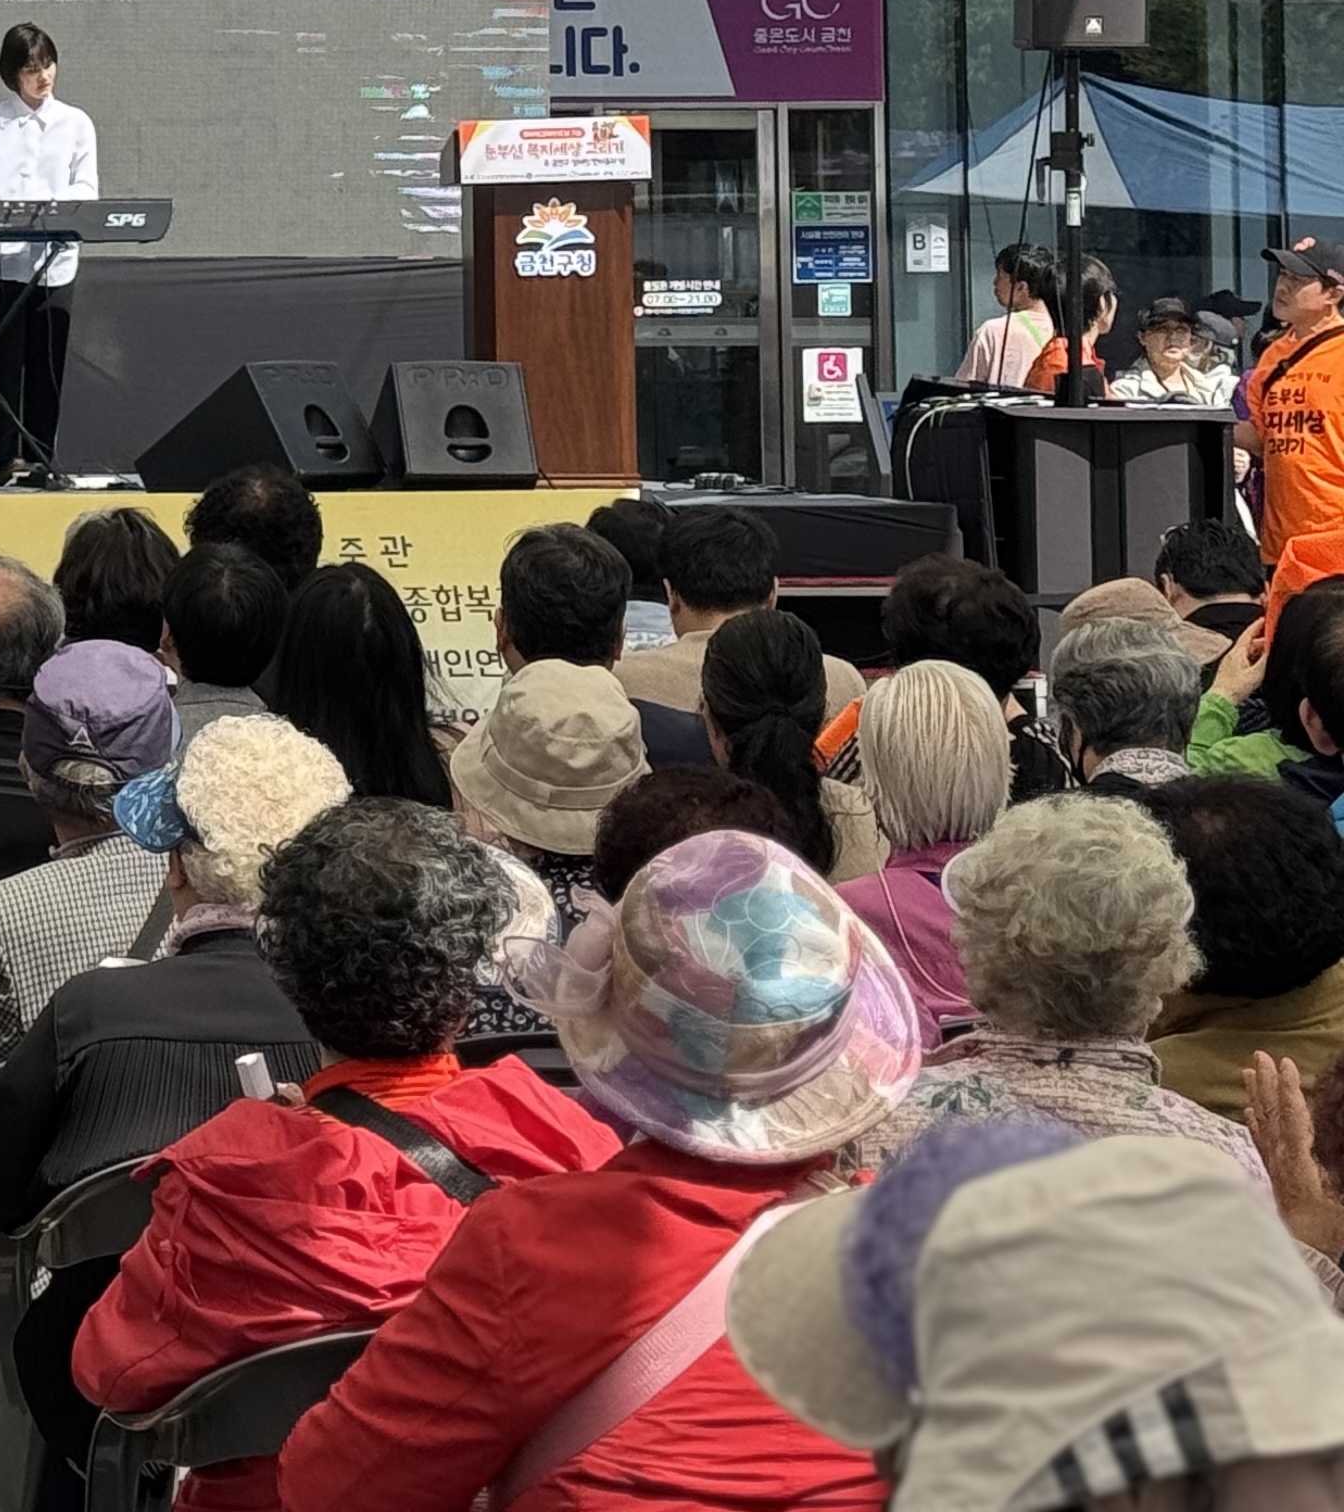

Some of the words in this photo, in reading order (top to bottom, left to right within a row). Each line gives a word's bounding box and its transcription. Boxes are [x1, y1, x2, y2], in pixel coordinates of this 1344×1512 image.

[753, 26, 816, 44] 좋은도시
[820, 26, 852, 43] 금천
[912, 233, 926, 251] B
[519, 253, 592, 273] 금천구청
[403, 584, 501, 624] 종합복
